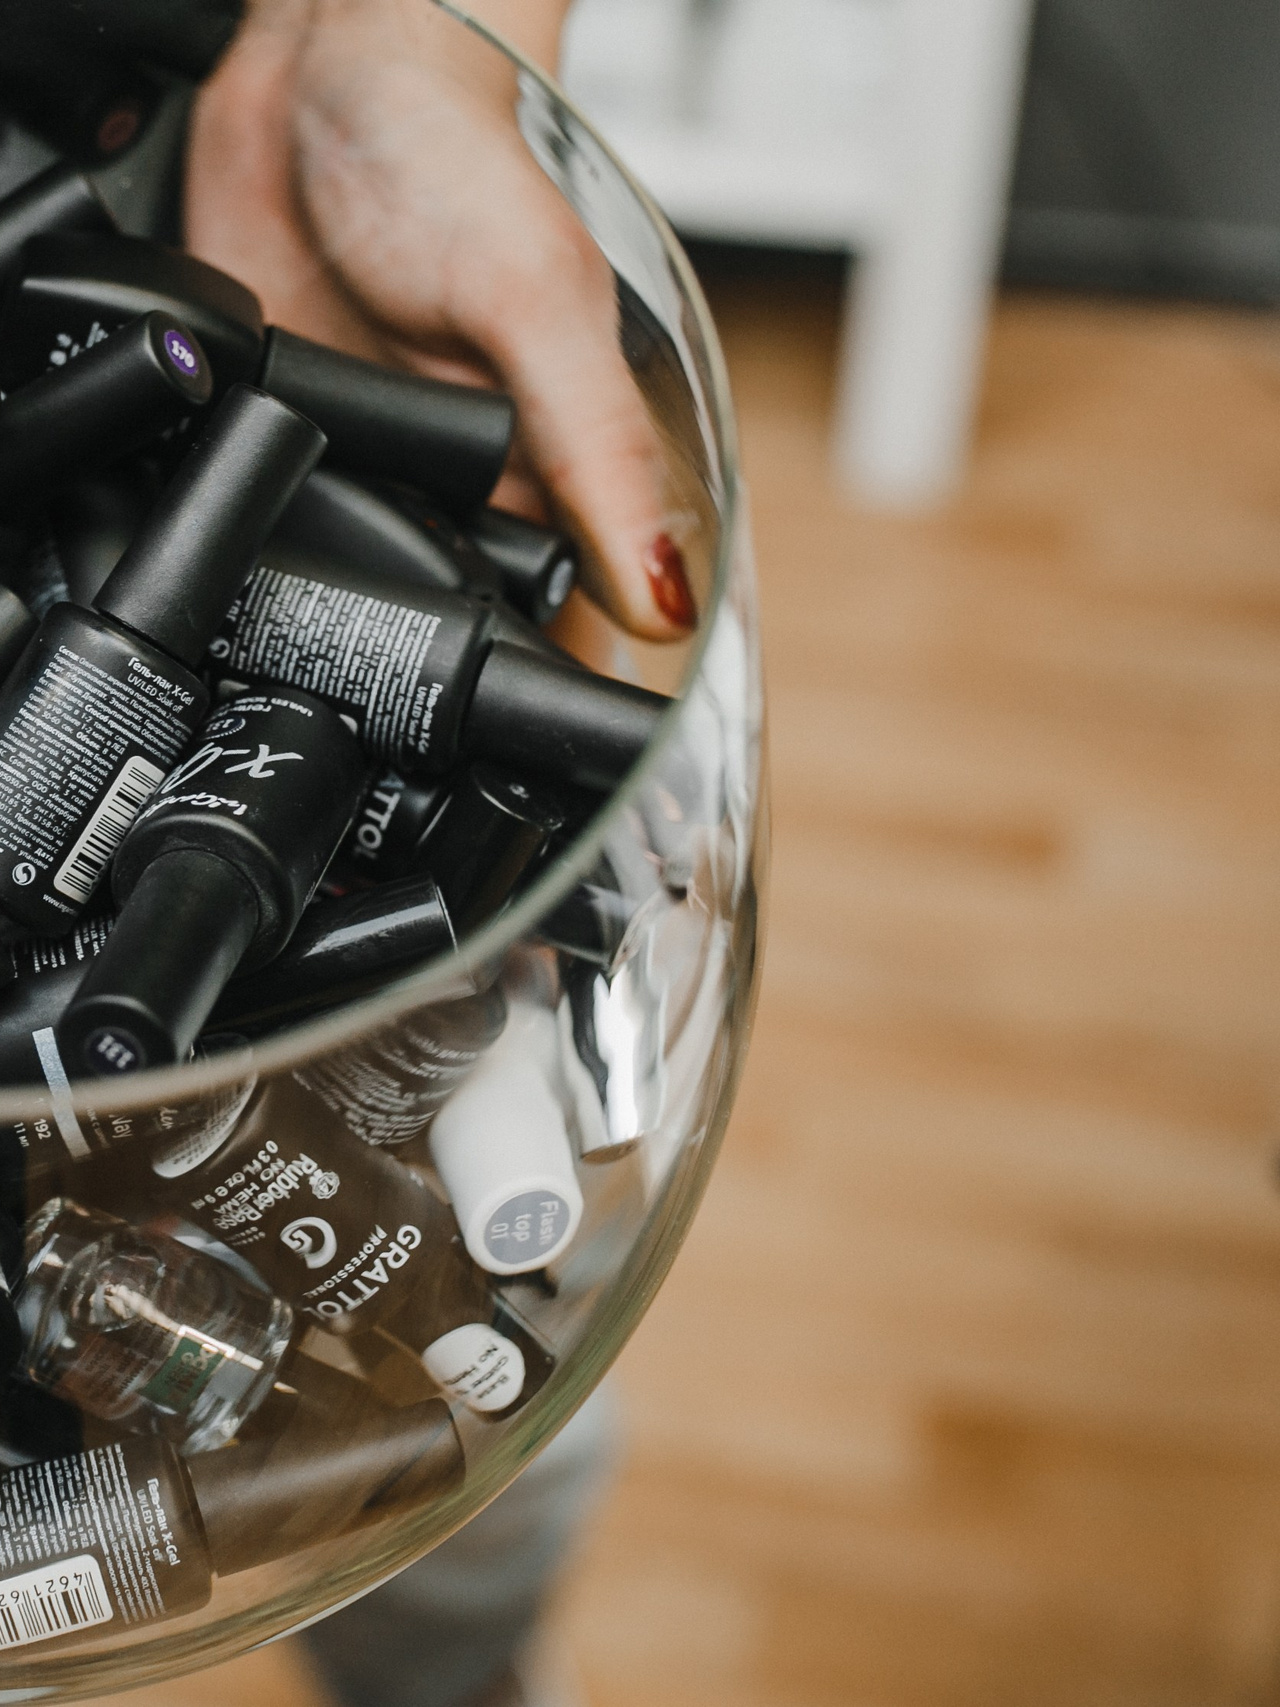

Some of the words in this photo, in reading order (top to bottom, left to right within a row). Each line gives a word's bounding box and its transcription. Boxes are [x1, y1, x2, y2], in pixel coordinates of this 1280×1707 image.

[128, 656, 173, 690] Гель-лак
[171, 684, 195, 706] X-Gel
[127, 673, 158, 697] UV/LED
[156, 692, 174, 708] Soak
[172, 704, 184, 714] off
[81, 712, 93, 723] 1-2
[84, 704, 110, 723] Способ
[81, 723, 93, 734] 1-2
[110, 742, 126, 755] ЛЕД
[102, 747, 109, 755] 8
[8, 755, 26, 770] Срок
[26, 767, 60, 791] годности:
[29, 736, 39, 744] от
[61, 755, 72, 765] Не
[71, 763, 104, 786] допускать
[93, 753, 114, 770] Беречь
[31, 780, 48, 794] ООО
[67, 769, 99, 793] Хранить:
[20, 804, 32, 815] ТУ
[14, 812, 54, 841] Произведено
[55, 839, 64, 847] на
[17, 849, 49, 870] упаковке
[33, 847, 54, 862] Дата
[13, 1121, 26, 1134] 11
[33, 1117, 52, 1140] 192
[249, 1151, 319, 1211] Rubber
[257, 1156, 287, 1184] NO
[212, 1181, 261, 1217] HEMA
[489, 1220, 512, 1242] 01
[509, 1211, 533, 1244] top
[534, 1198, 561, 1248] Flash
[147, 1478, 168, 1531] Гель-лак
[161, 1531, 181, 1566] X-Gel
[145, 1524, 159, 1547] Soak
